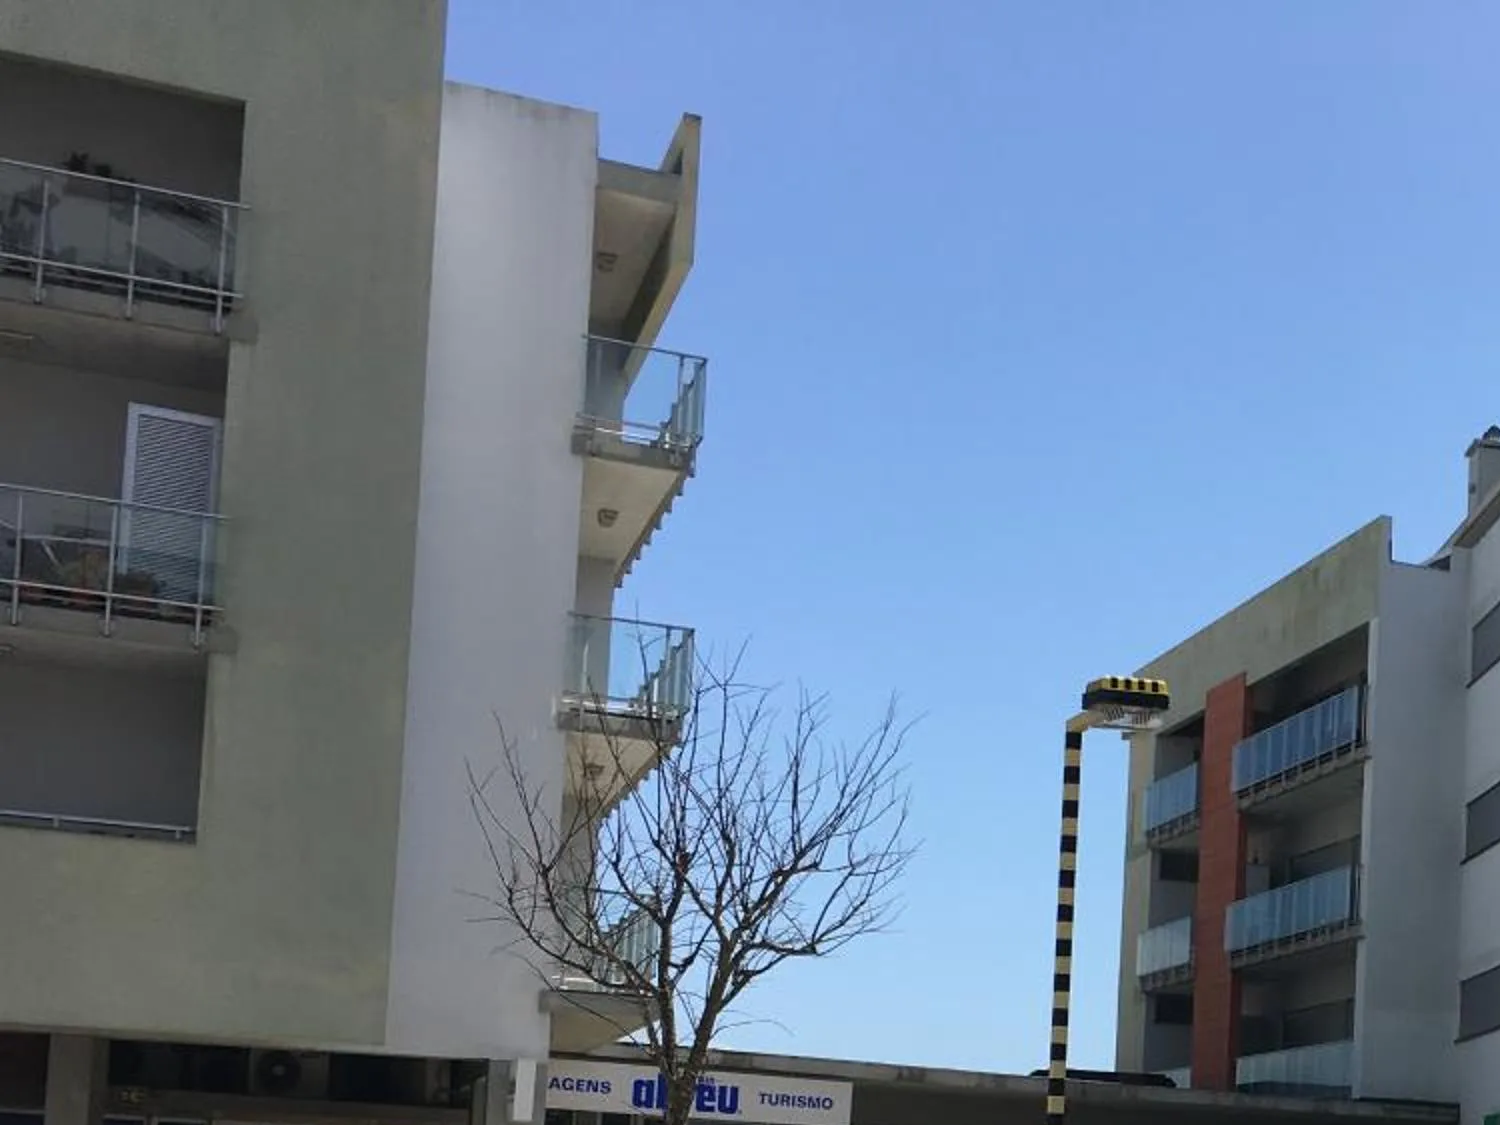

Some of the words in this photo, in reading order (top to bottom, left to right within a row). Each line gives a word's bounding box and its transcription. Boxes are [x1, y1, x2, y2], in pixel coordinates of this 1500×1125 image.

[549, 1075, 611, 1095] AGENS
[632, 1072, 740, 1115] abeu
[759, 1091, 834, 1110] TURISMO
